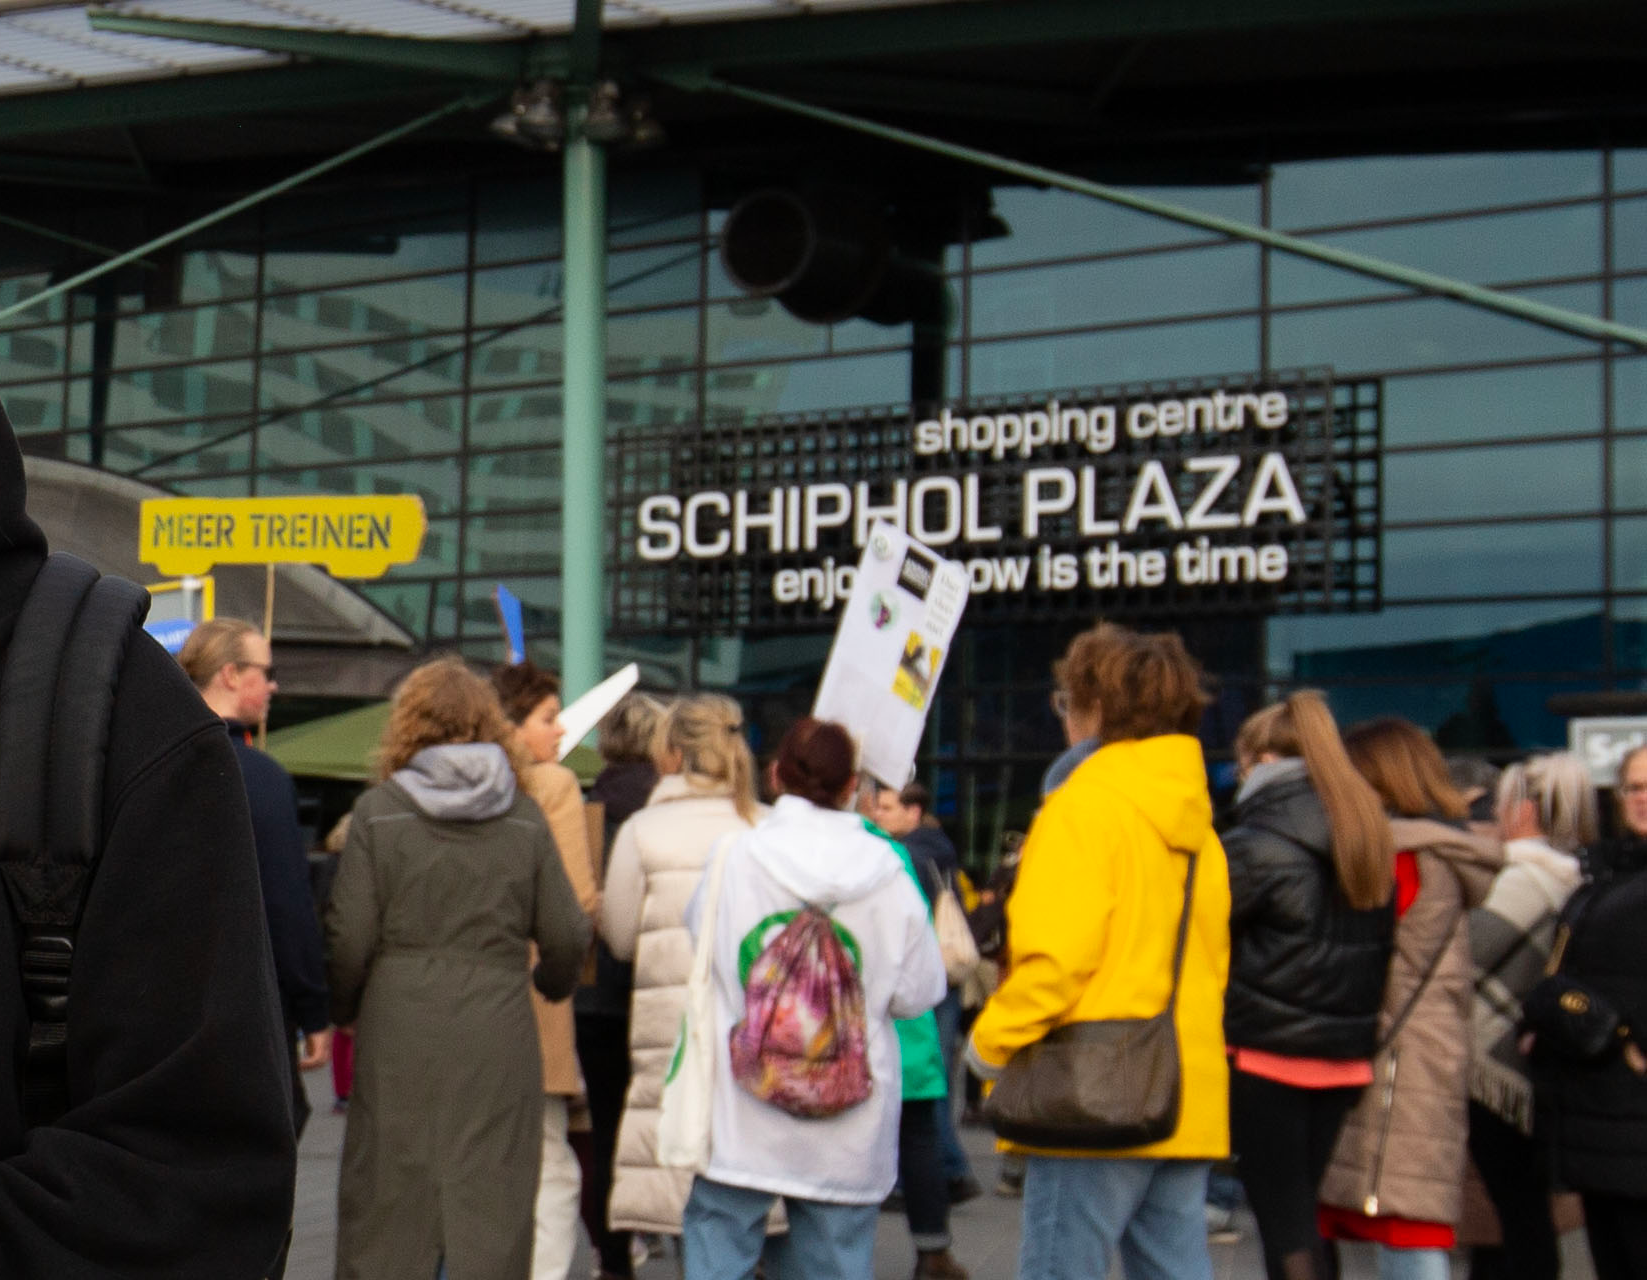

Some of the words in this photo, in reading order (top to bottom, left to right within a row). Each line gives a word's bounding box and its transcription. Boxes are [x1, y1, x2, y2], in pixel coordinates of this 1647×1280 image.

[914, 399, 1117, 460] shopping
[1125, 389, 1289, 439] centre
[152, 513, 236, 549] MEER
[248, 513, 392, 550] TREINEN
[636, 471, 1003, 562] SCHIPHOL
[1022, 451, 1308, 540] PLAZA
[772, 555, 858, 611] enjo
[1037, 543, 1079, 591] is
[1085, 540, 1167, 589] the
[1172, 535, 1289, 585] time
